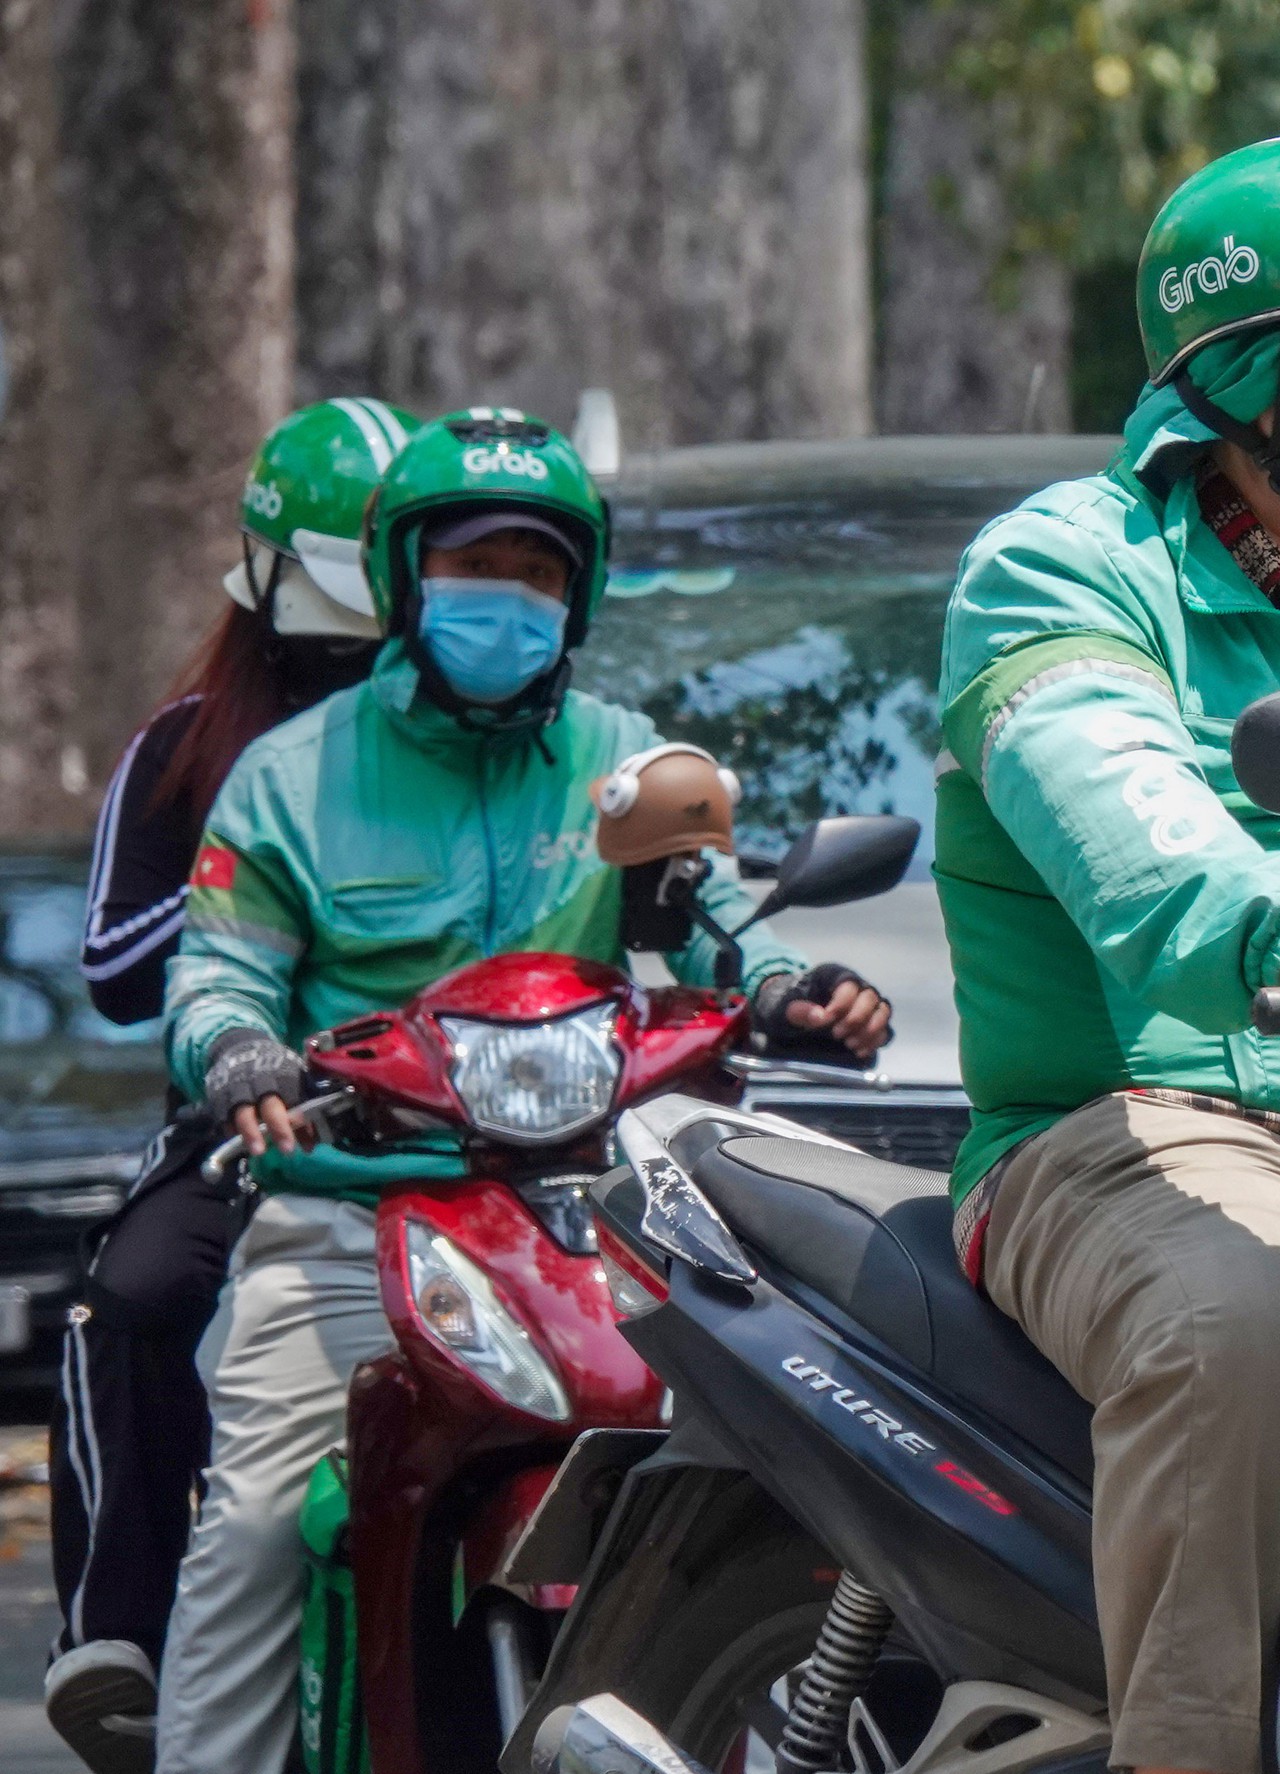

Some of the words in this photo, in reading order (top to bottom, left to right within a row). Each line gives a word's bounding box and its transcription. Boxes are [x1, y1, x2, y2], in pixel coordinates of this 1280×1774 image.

[1158, 234, 1260, 314] Grab
[462, 447, 549, 481] Grab
[781, 1353, 937, 1456] UTURE
